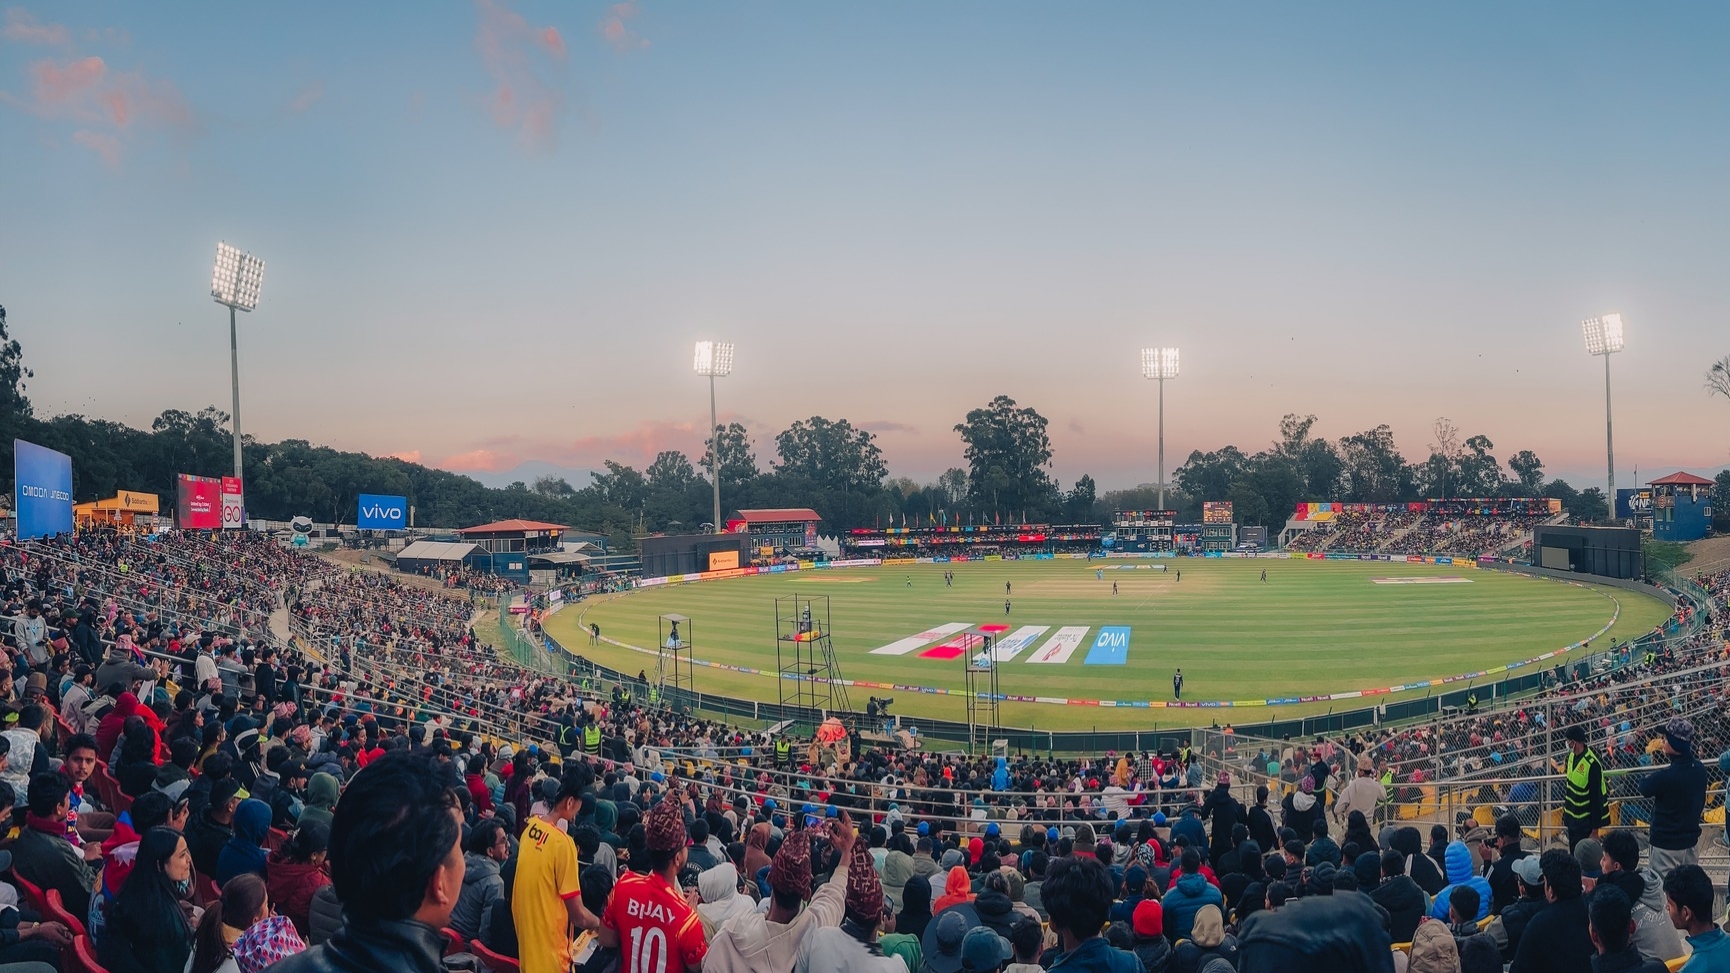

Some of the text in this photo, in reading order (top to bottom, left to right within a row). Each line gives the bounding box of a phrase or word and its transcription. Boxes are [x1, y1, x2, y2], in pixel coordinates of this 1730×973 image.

[22, 485, 48, 499] OMODA
[223, 505, 241, 523] GO
[362, 503, 402, 520] vivo
[1098, 632, 1125, 653] vivo
[627, 897, 676, 925] BIJAY
[630, 926, 667, 973] 10
